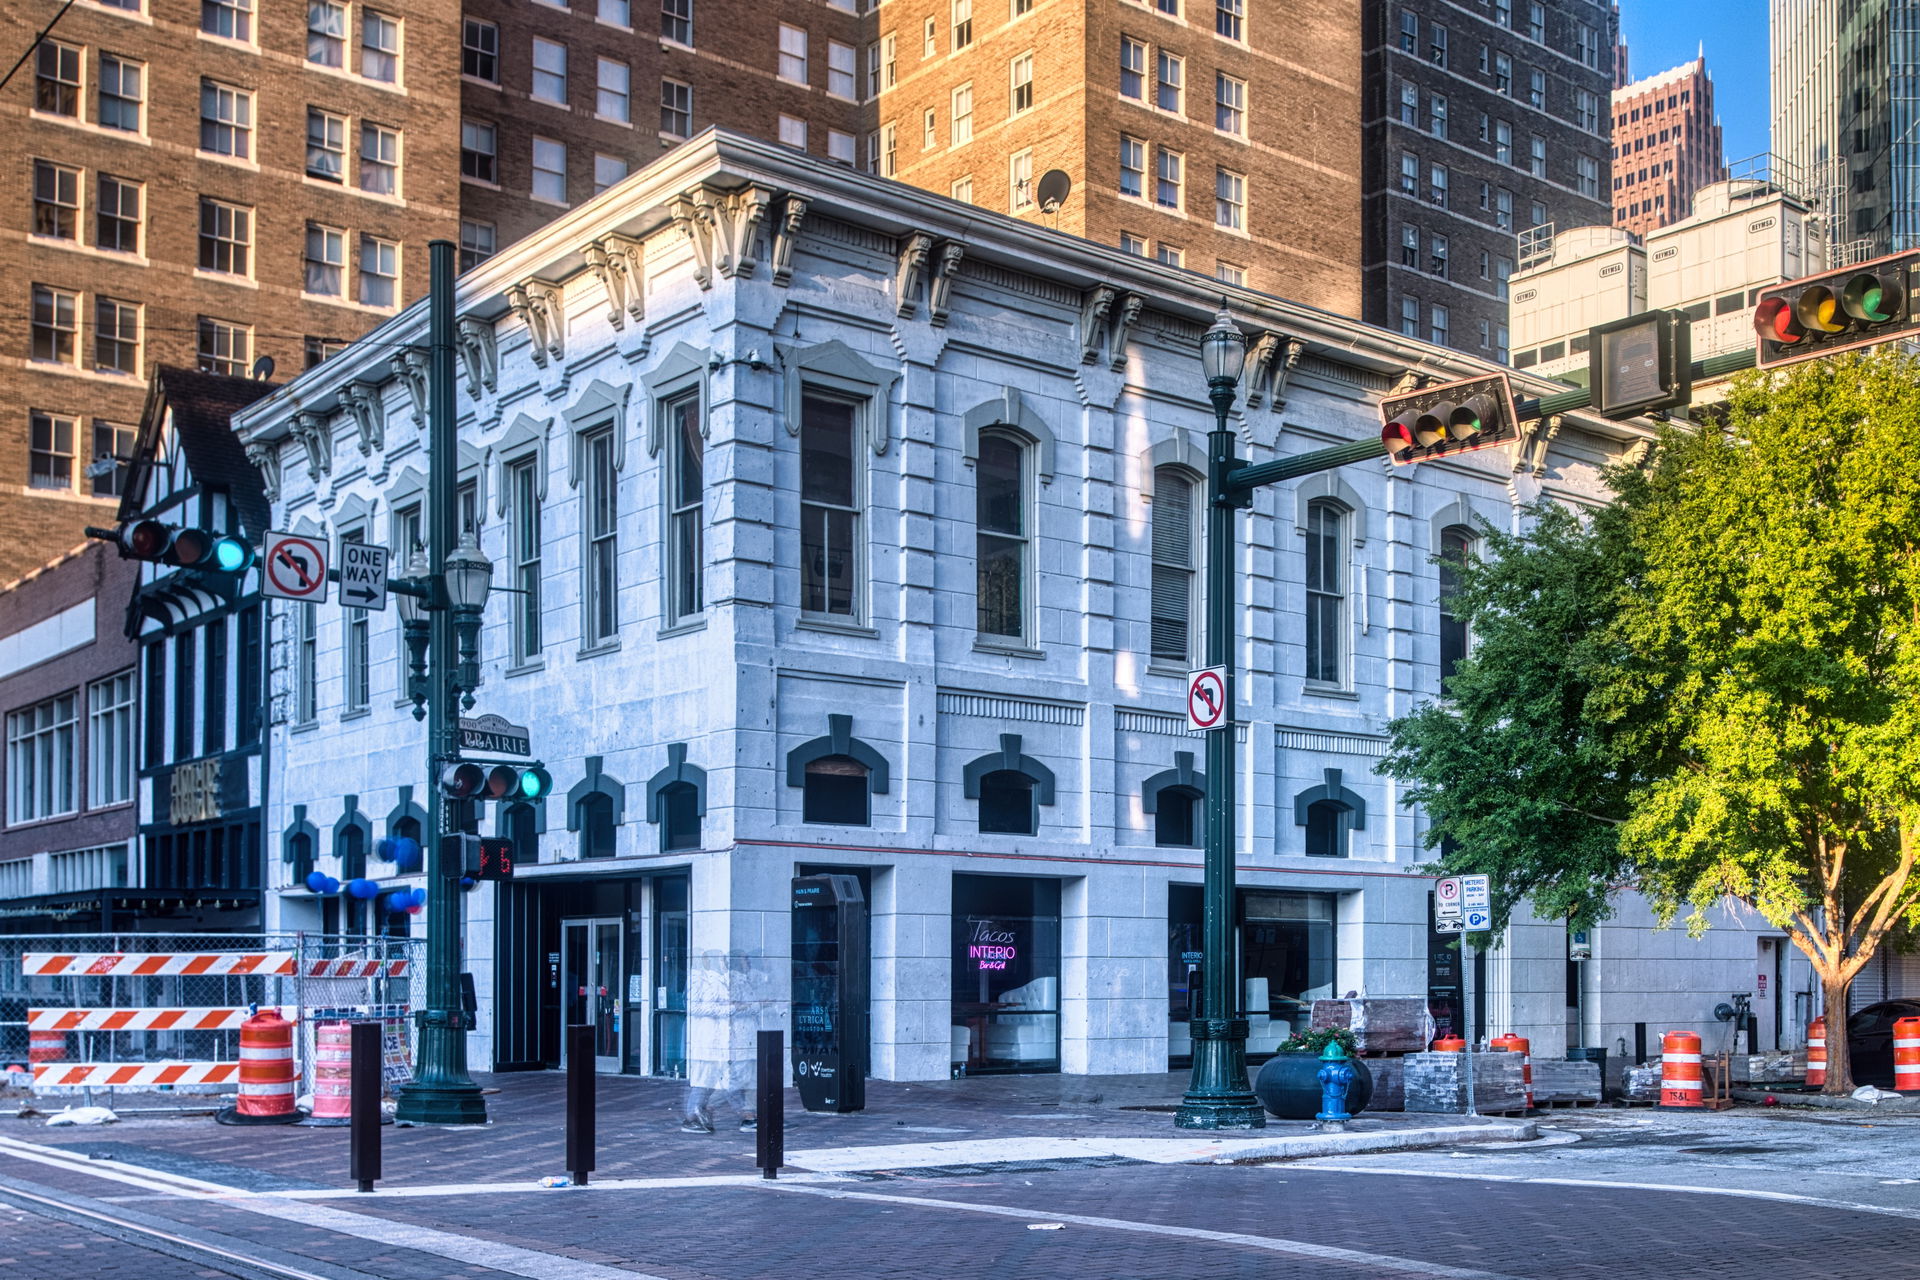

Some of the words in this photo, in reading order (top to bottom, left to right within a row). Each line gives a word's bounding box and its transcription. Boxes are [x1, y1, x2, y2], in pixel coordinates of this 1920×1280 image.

[347, 547, 382, 567] ONE
[346, 565, 382, 585] WAY
[460, 720, 477, 730] 900
[464, 731, 527, 754] PRAIRIE
[966, 919, 1016, 944] Tacos
[969, 944, 1016, 960] INTERIO
